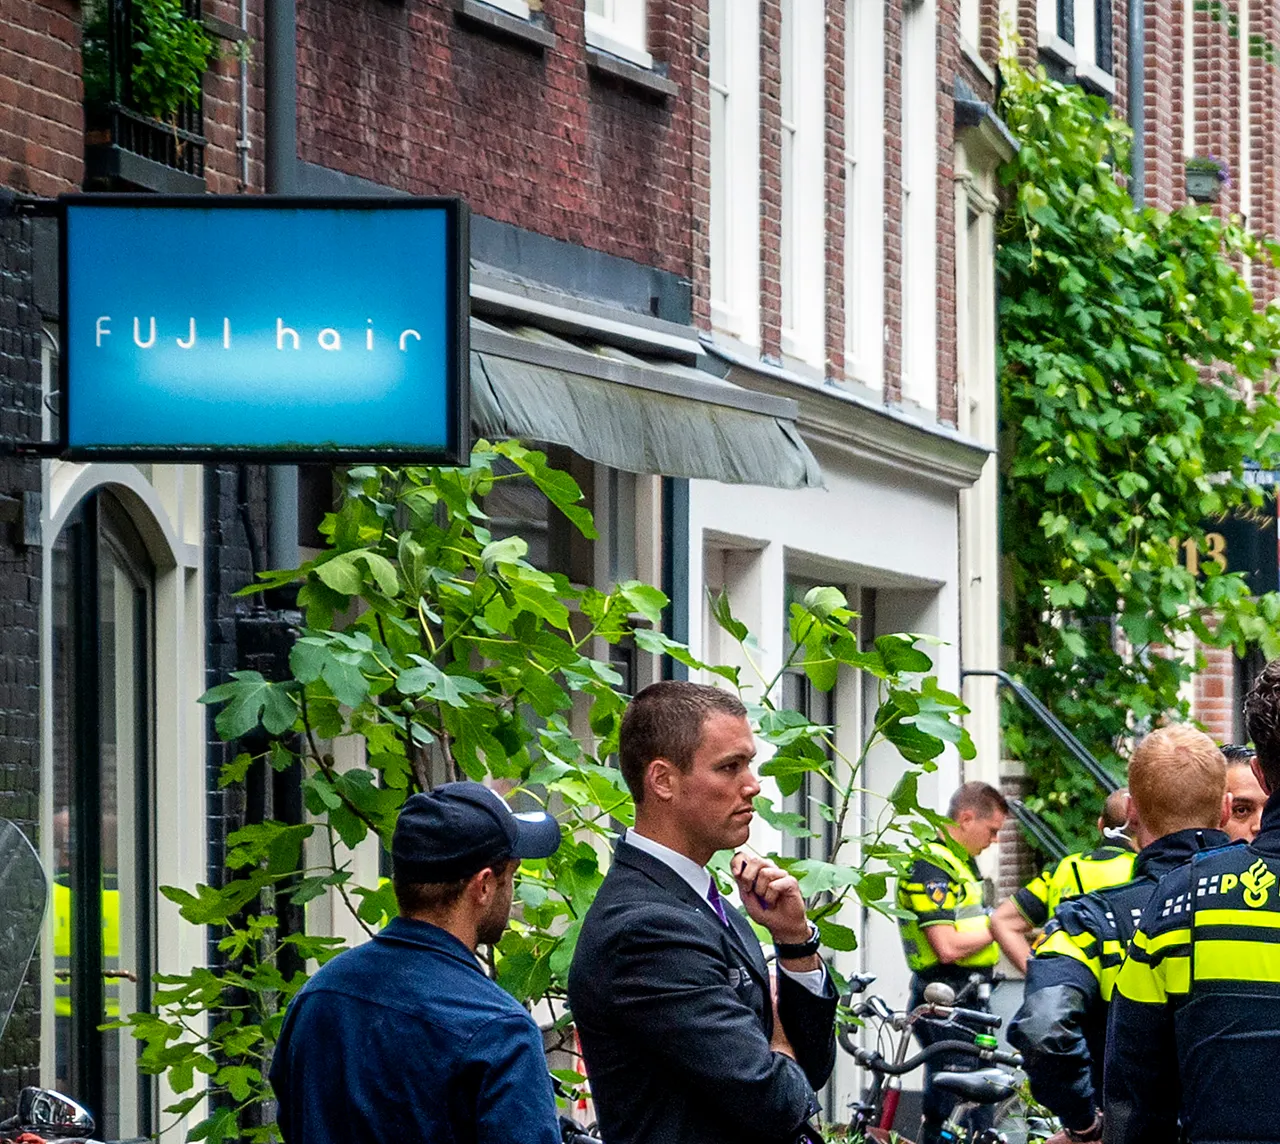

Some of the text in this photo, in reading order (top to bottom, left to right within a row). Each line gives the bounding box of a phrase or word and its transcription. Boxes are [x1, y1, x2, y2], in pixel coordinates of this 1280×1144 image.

[95, 316, 422, 352] FUJI hair
[1169, 532, 1228, 577] 13
